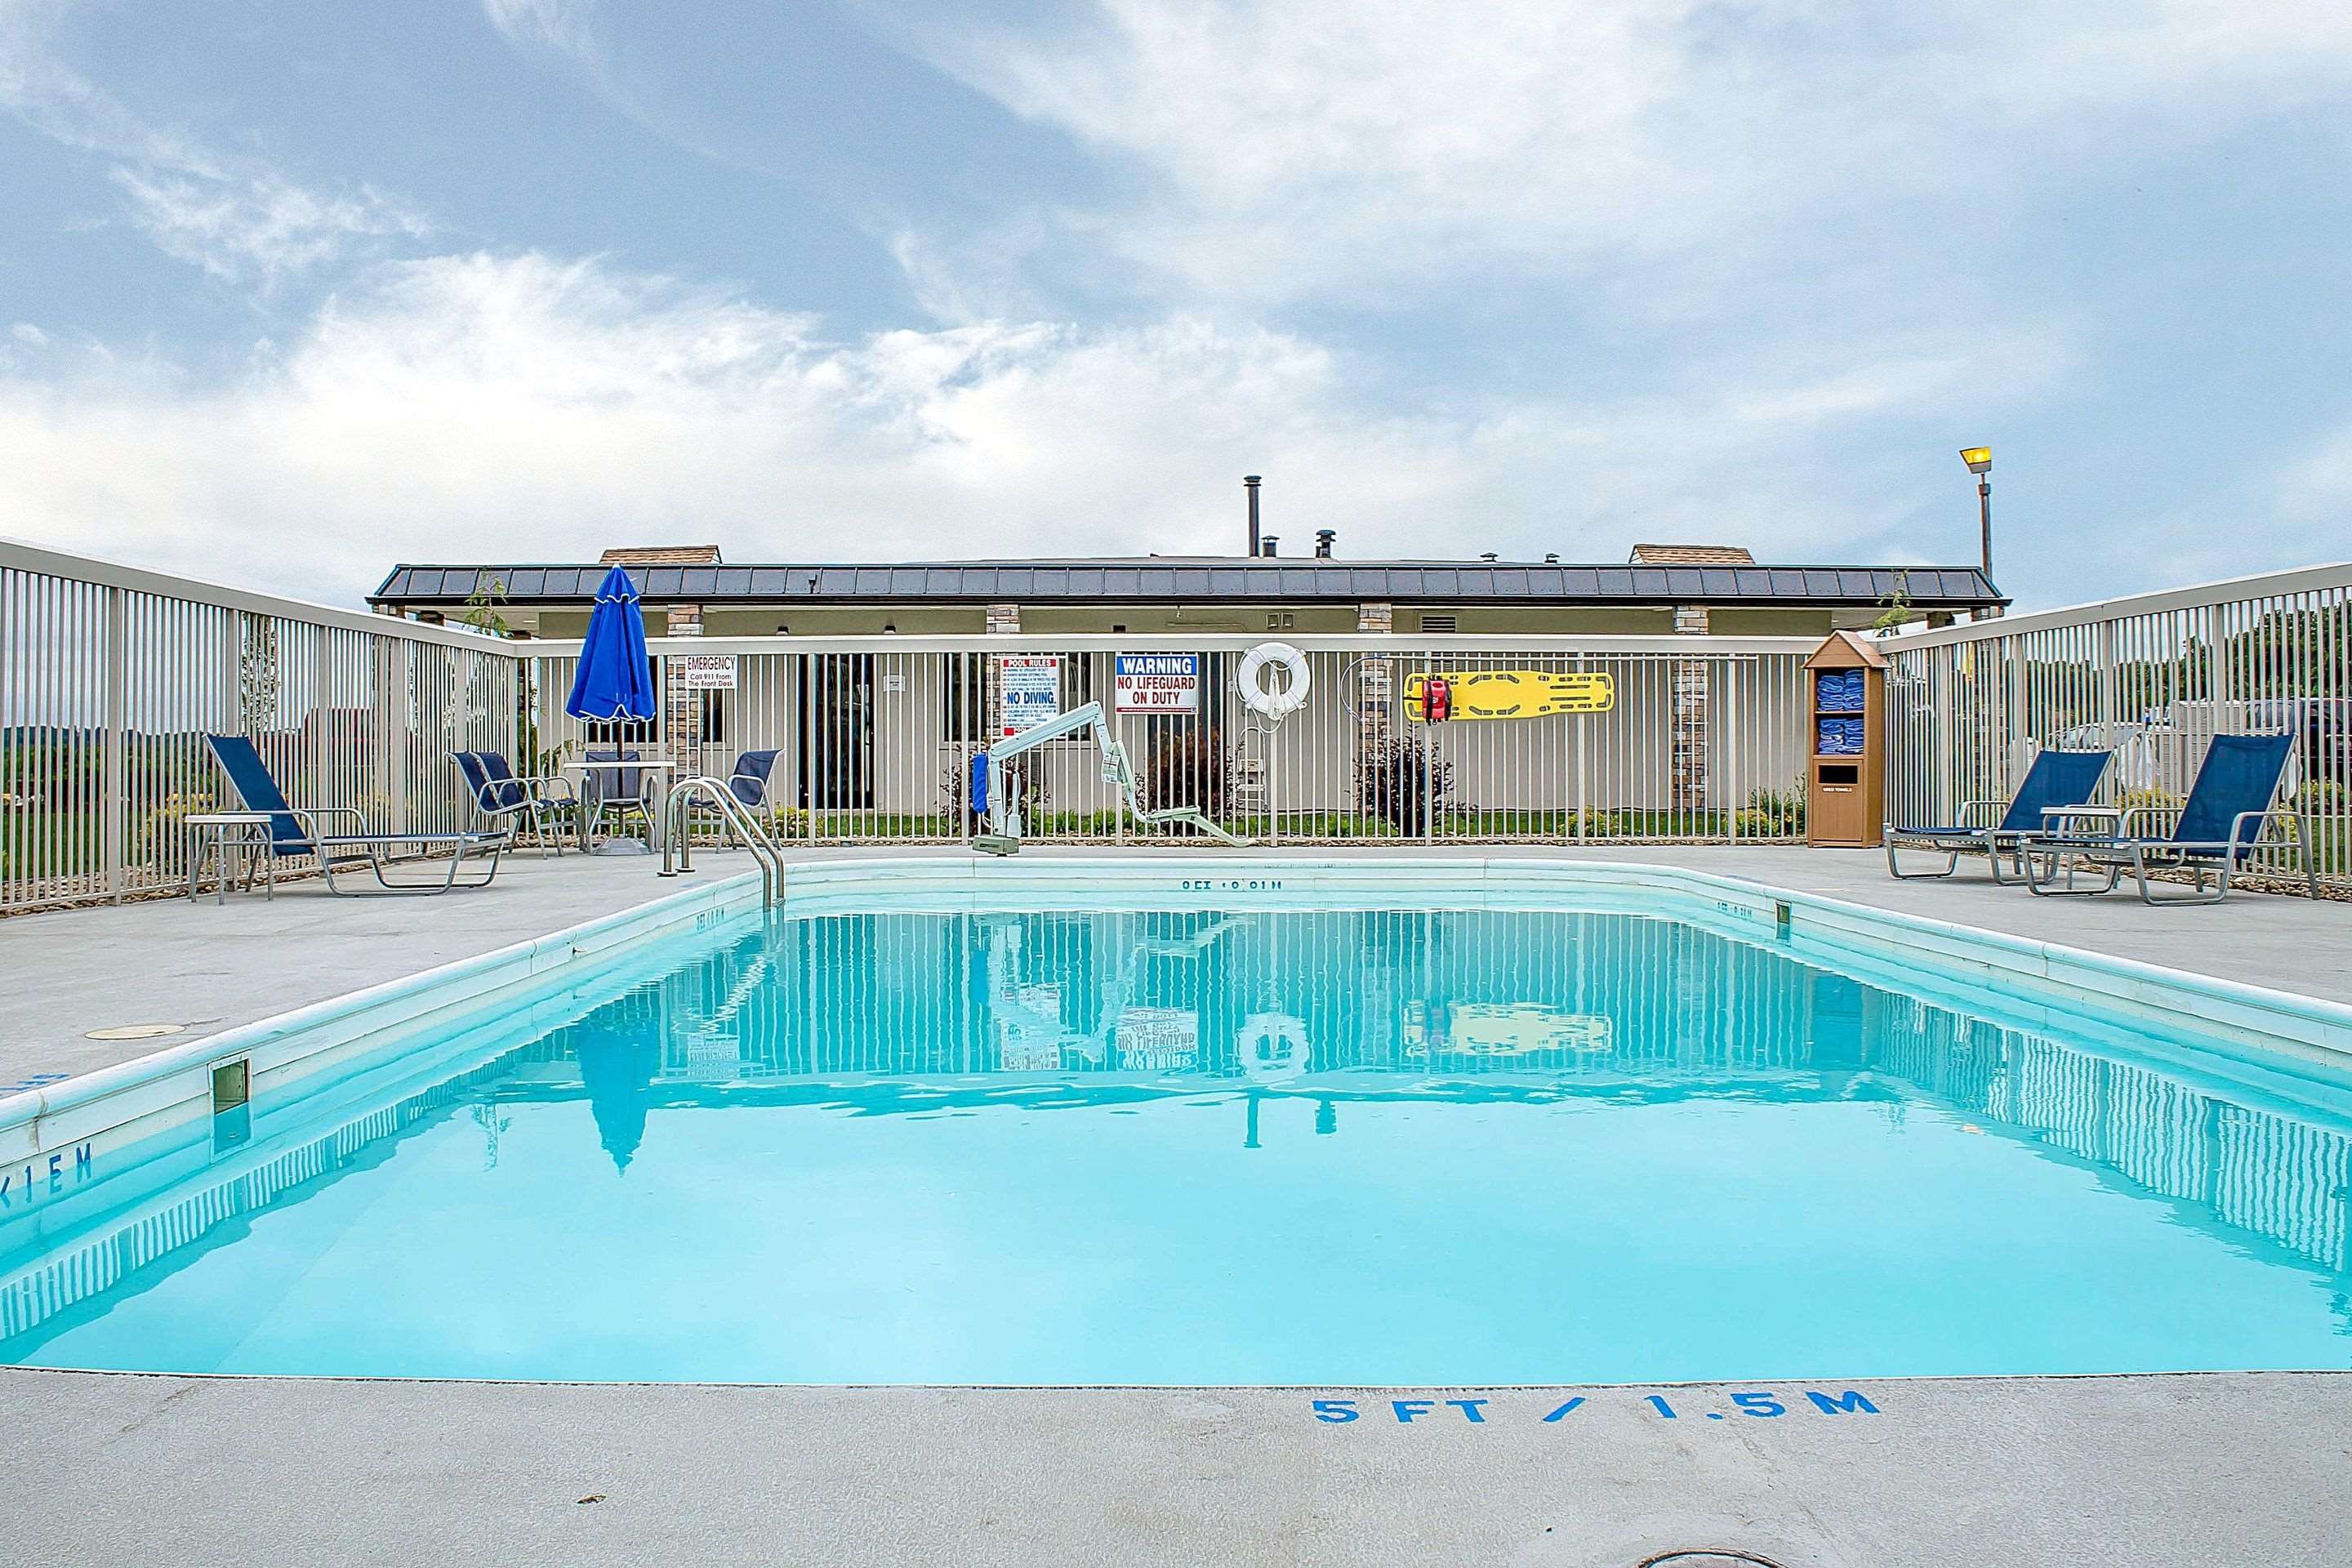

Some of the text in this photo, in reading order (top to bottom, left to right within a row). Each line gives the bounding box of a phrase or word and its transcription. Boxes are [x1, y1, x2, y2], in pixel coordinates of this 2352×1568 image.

[688, 657, 735, 670] EMERGENCY
[1122, 657, 1192, 674] WARNING
[1117, 676, 1195, 690] NO LIFEGUARD
[1007, 692, 1020, 705] NO
[1133, 691, 1180, 704] ON DUTY
[1313, 1400, 1359, 1423] 5
[1392, 1400, 1488, 1423] FT
